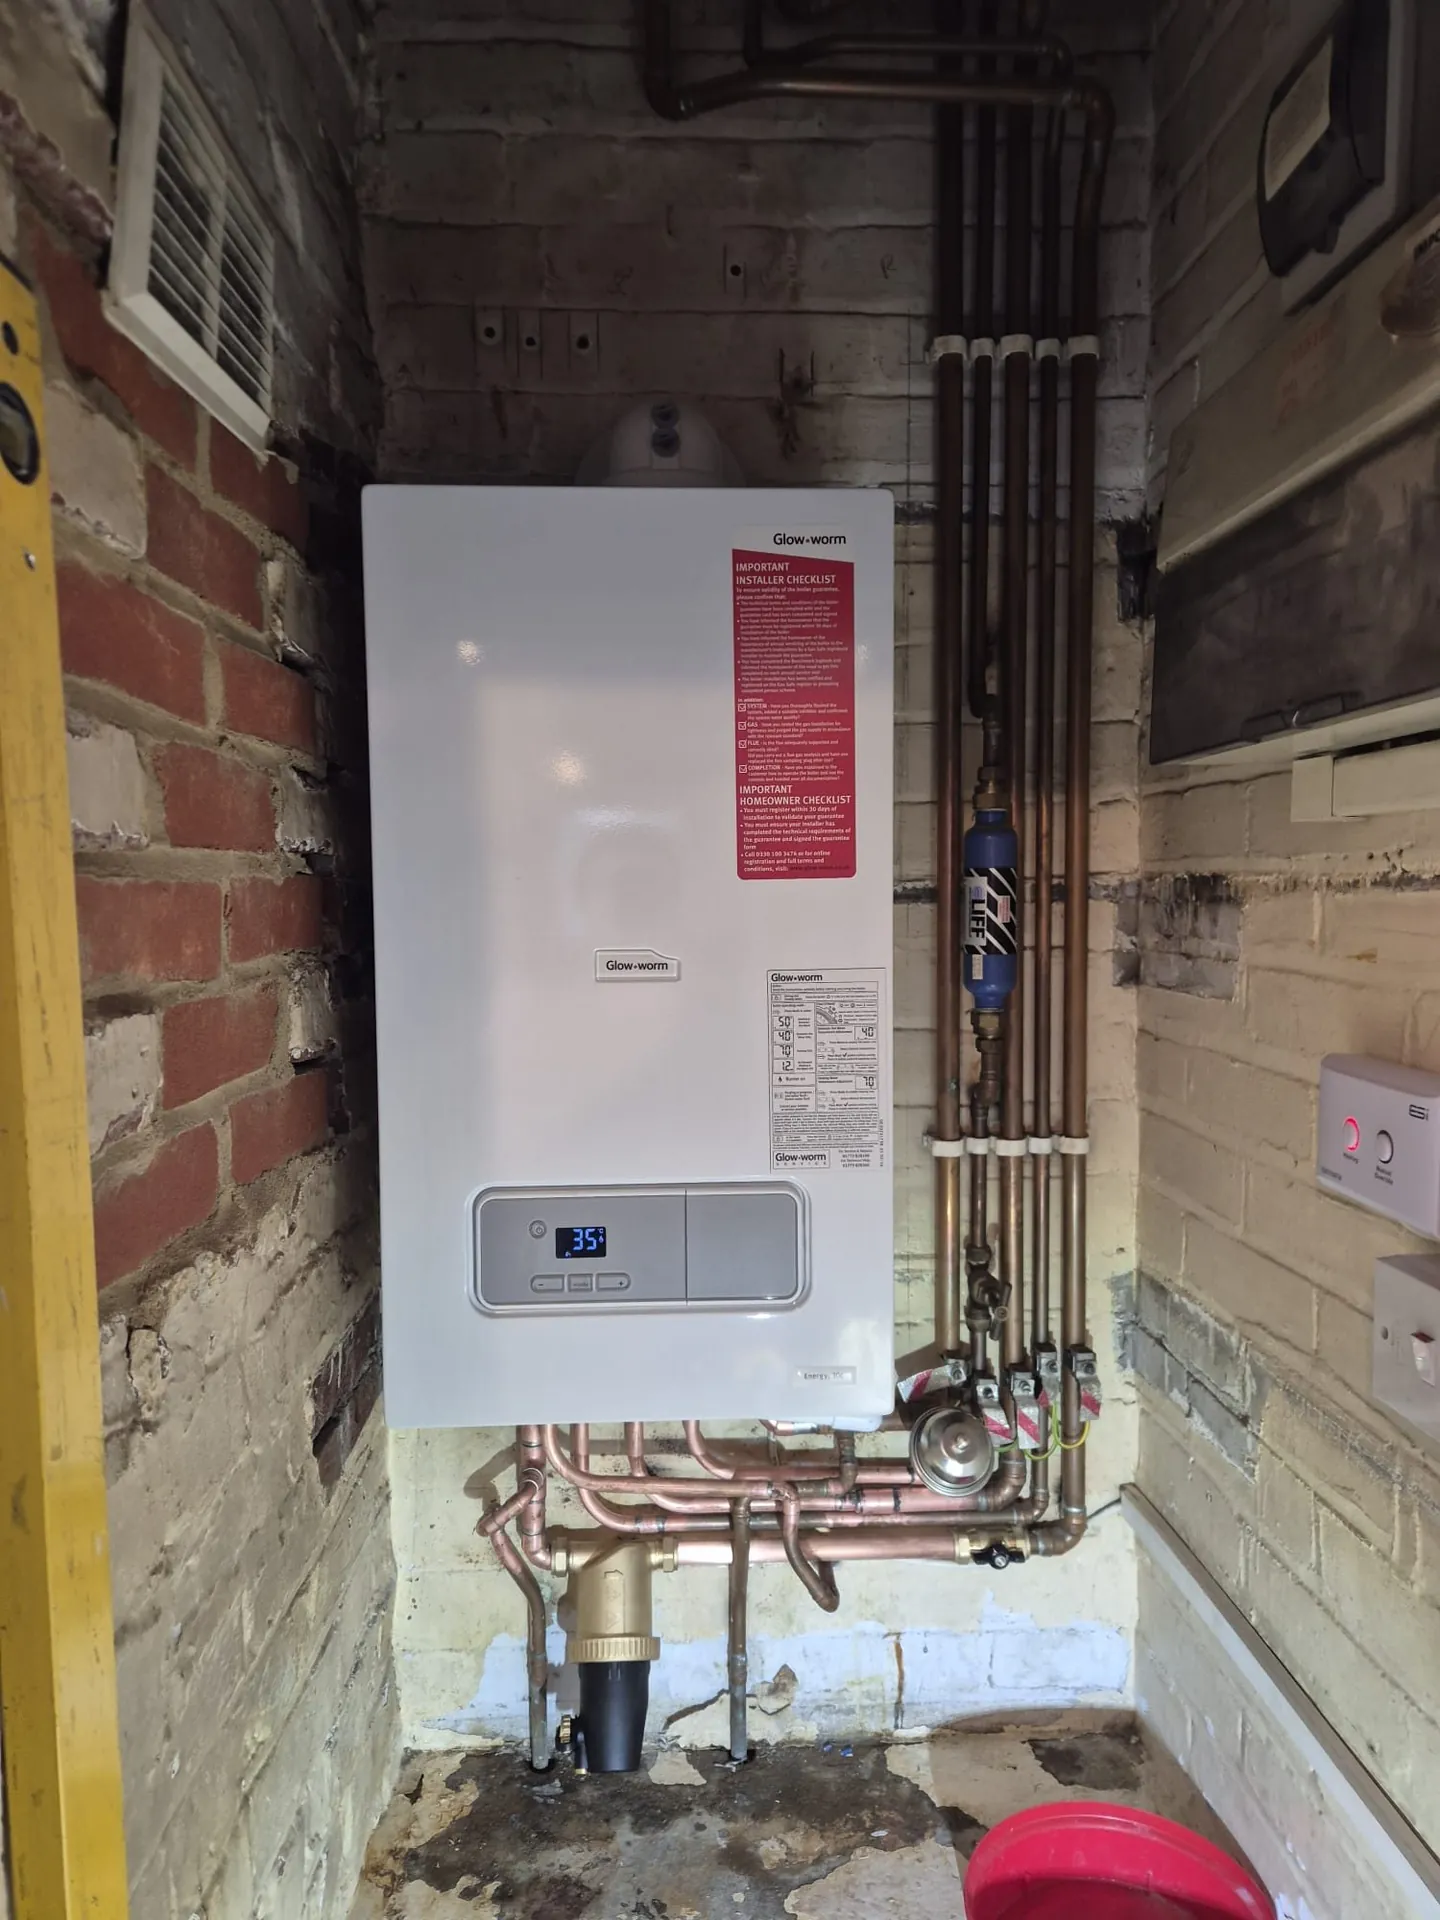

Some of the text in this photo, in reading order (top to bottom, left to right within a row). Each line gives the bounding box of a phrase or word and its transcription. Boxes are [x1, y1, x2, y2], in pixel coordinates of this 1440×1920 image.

[736, 562, 790, 572] IMPORTANT
[736, 574, 836, 585] INSTALLER CHECKLIST
[740, 785, 792, 794] IMPORTANT
[740, 795, 851, 806] HOMEOWNER CHECKLIST
[971, 899, 985, 938] LIFF
[778, 1016, 791, 1027] 50
[778, 1030, 791, 1041] 40
[862, 1027, 874, 1037] 40
[863, 1076, 874, 1087] 70
[573, 1228, 597, 1250] 35
